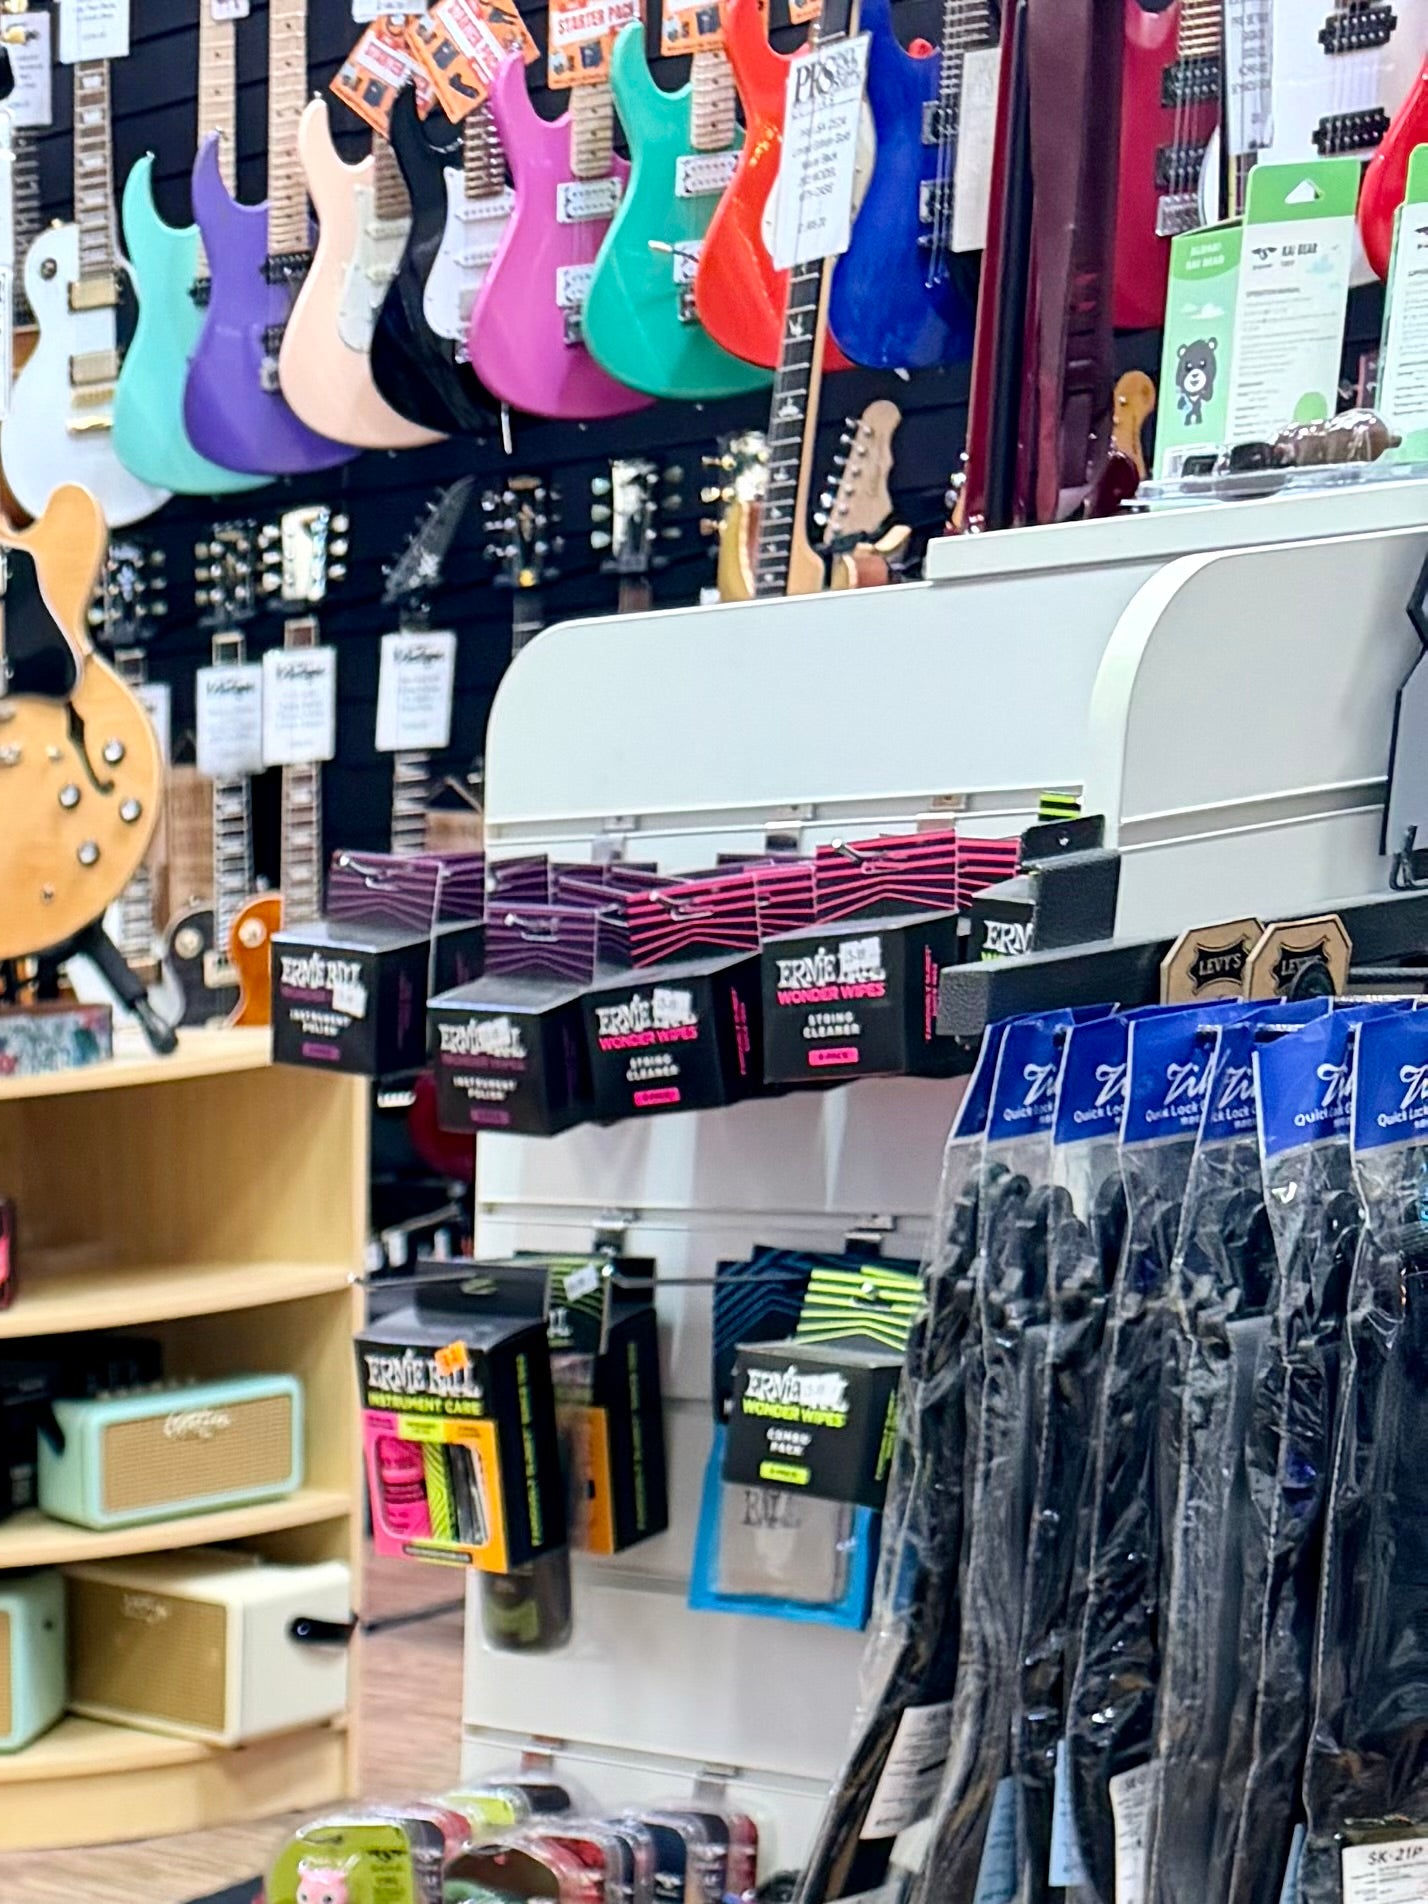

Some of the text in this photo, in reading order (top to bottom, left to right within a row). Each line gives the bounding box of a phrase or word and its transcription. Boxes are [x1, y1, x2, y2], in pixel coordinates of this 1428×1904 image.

[985, 919, 1033, 956] ERN
[1198, 953, 1242, 976] LEVY'S
[775, 981, 886, 1006] WONDER WIPES
[807, 1011, 856, 1027] STRING
[597, 1025, 698, 1052] WONDER WIPES
[802, 1023, 861, 1040] CLEANER
[446, 1399, 484, 1416] CARE
